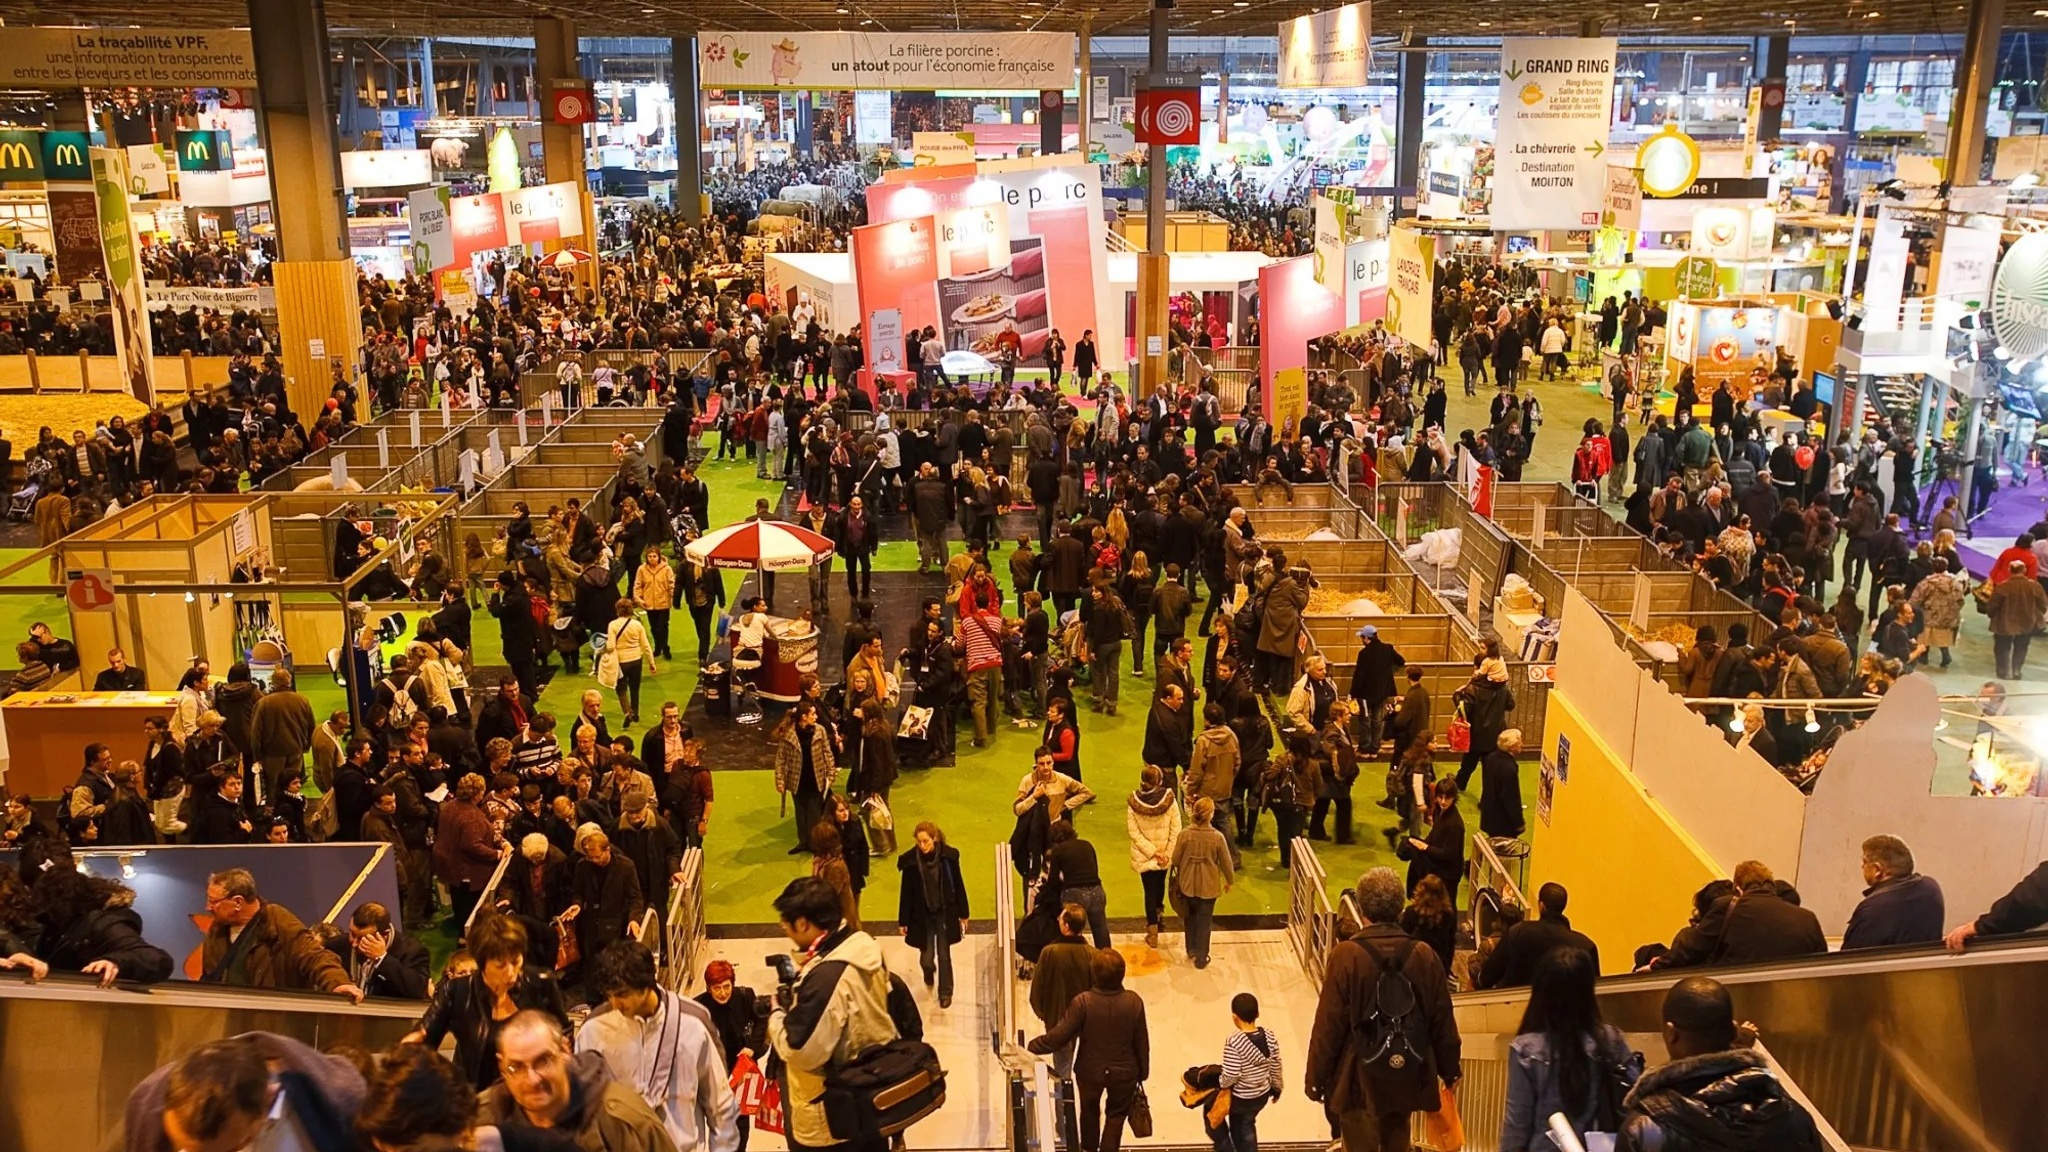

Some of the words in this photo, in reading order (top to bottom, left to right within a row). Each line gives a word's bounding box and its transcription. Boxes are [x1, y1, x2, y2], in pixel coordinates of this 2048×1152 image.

[77, 35, 95, 48] La
[100, 34, 172, 52] traçabilité
[175, 35, 208, 50] VPF,
[889, 44, 905, 57] La
[908, 43, 943, 57] filière
[946, 44, 994, 61] porcine
[46, 54, 73, 64] une
[75, 50, 156, 65] information
[158, 51, 243, 68] transparente
[832, 62, 849, 72] un
[852, 59, 890, 72] atout
[893, 61, 923, 76] pour
[926, 57, 995, 72] l'économie
[998, 58, 1055, 76] française
[1526, 59, 1573, 74] GRAND
[1577, 59, 1610, 74] RING
[14, 69, 50, 80] entre
[53, 66, 71, 80] les
[75, 65, 131, 81] éleveurs
[133, 68, 148, 80] et
[151, 67, 169, 80] les
[1165, 77, 1184, 85] 1113
[1565, 79, 1581, 88] Ring
[1558, 87, 1574, 95] Salle
[1517, 111, 1529, 119] Les
[1515, 143, 1527, 154] La
[1530, 143, 1576, 154] chèvrerie
[1521, 161, 1575, 173] Destination
[1531, 177, 1574, 187] MOUTON
[1000, 184, 1020, 206] le
[509, 200, 523, 216] le
[1583, 214, 1598, 225] RTL
[942, 224, 954, 242] le
[1353, 259, 1366, 281] le
[158, 291, 169, 301] Le
[171, 292, 190, 301] Porc
[192, 291, 212, 301] Noir
[213, 291, 223, 301] de
[226, 291, 258, 303] Bigorre
[713, 558, 752, 567] Häagen-Dazs
[768, 557, 806, 568] Häagen-Dazs
